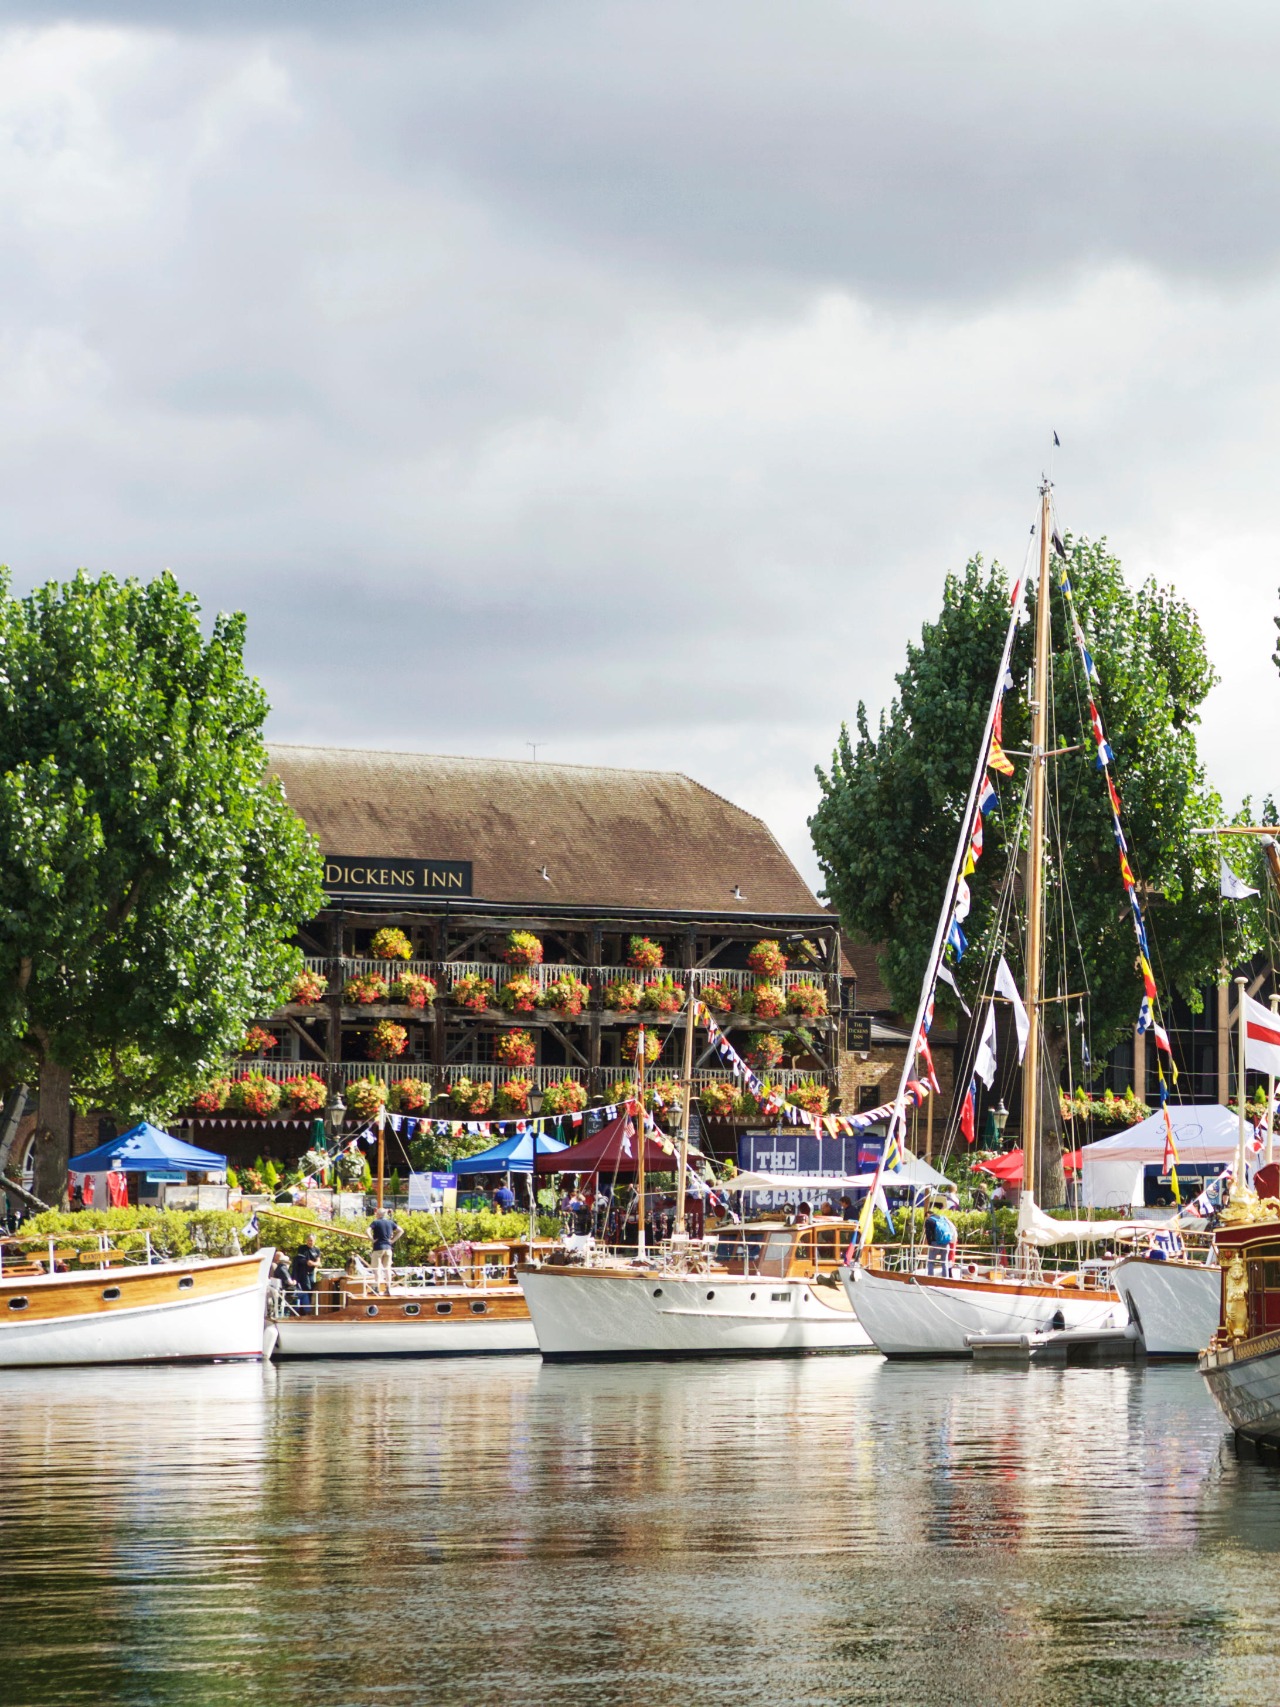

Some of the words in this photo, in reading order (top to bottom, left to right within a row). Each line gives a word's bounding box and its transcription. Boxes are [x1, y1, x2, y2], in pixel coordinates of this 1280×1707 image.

[325, 864, 415, 887] DICKENS
[423, 868, 463, 888] INN
[756, 1151, 796, 1169] THE
